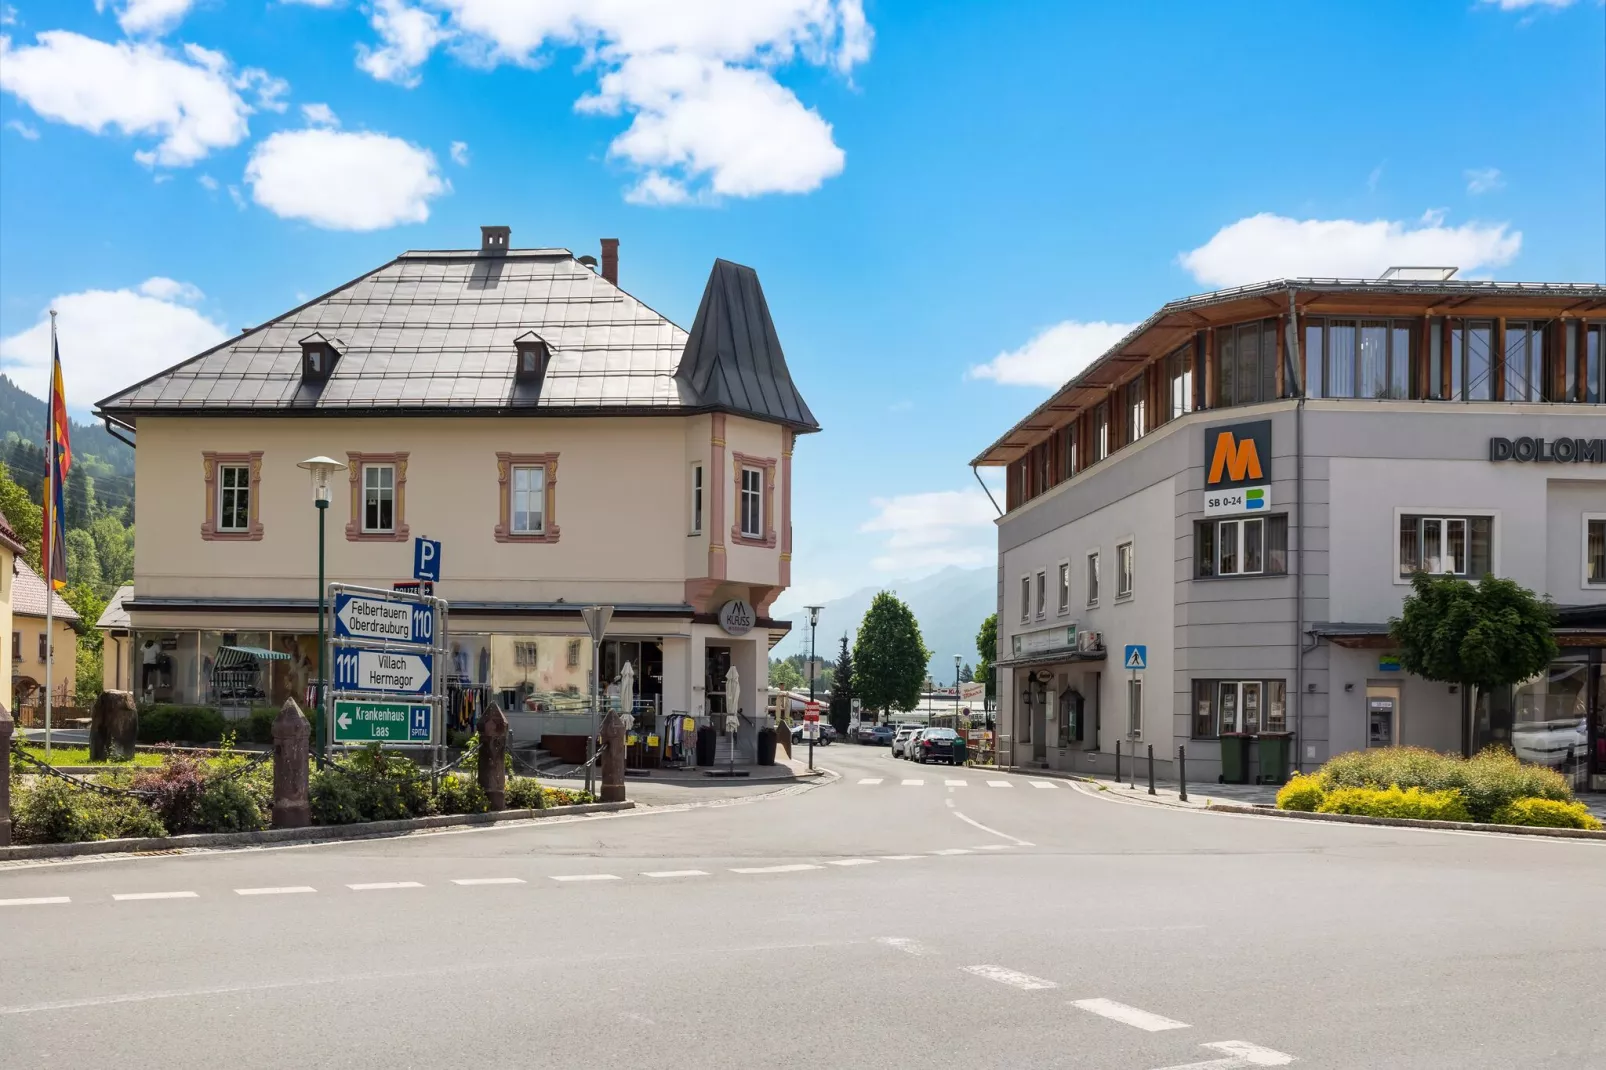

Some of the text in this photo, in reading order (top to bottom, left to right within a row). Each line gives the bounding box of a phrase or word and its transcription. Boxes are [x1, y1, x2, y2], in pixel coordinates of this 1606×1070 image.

[1208, 496, 1242, 508] SB 0-24
[421, 541, 434, 569] P
[351, 601, 408, 620] Felbertauern
[349, 617, 409, 638] Oberdrauburg
[414, 610, 432, 639] 110
[336, 654, 358, 684] 111
[378, 655, 407, 670] Villach
[369, 670, 413, 689] Hermagor
[355, 706, 405, 722] Krankenhaus
[415, 710, 425, 727] H
[371, 723, 390, 737] Laas
[411, 728, 428, 736] SPITAL
